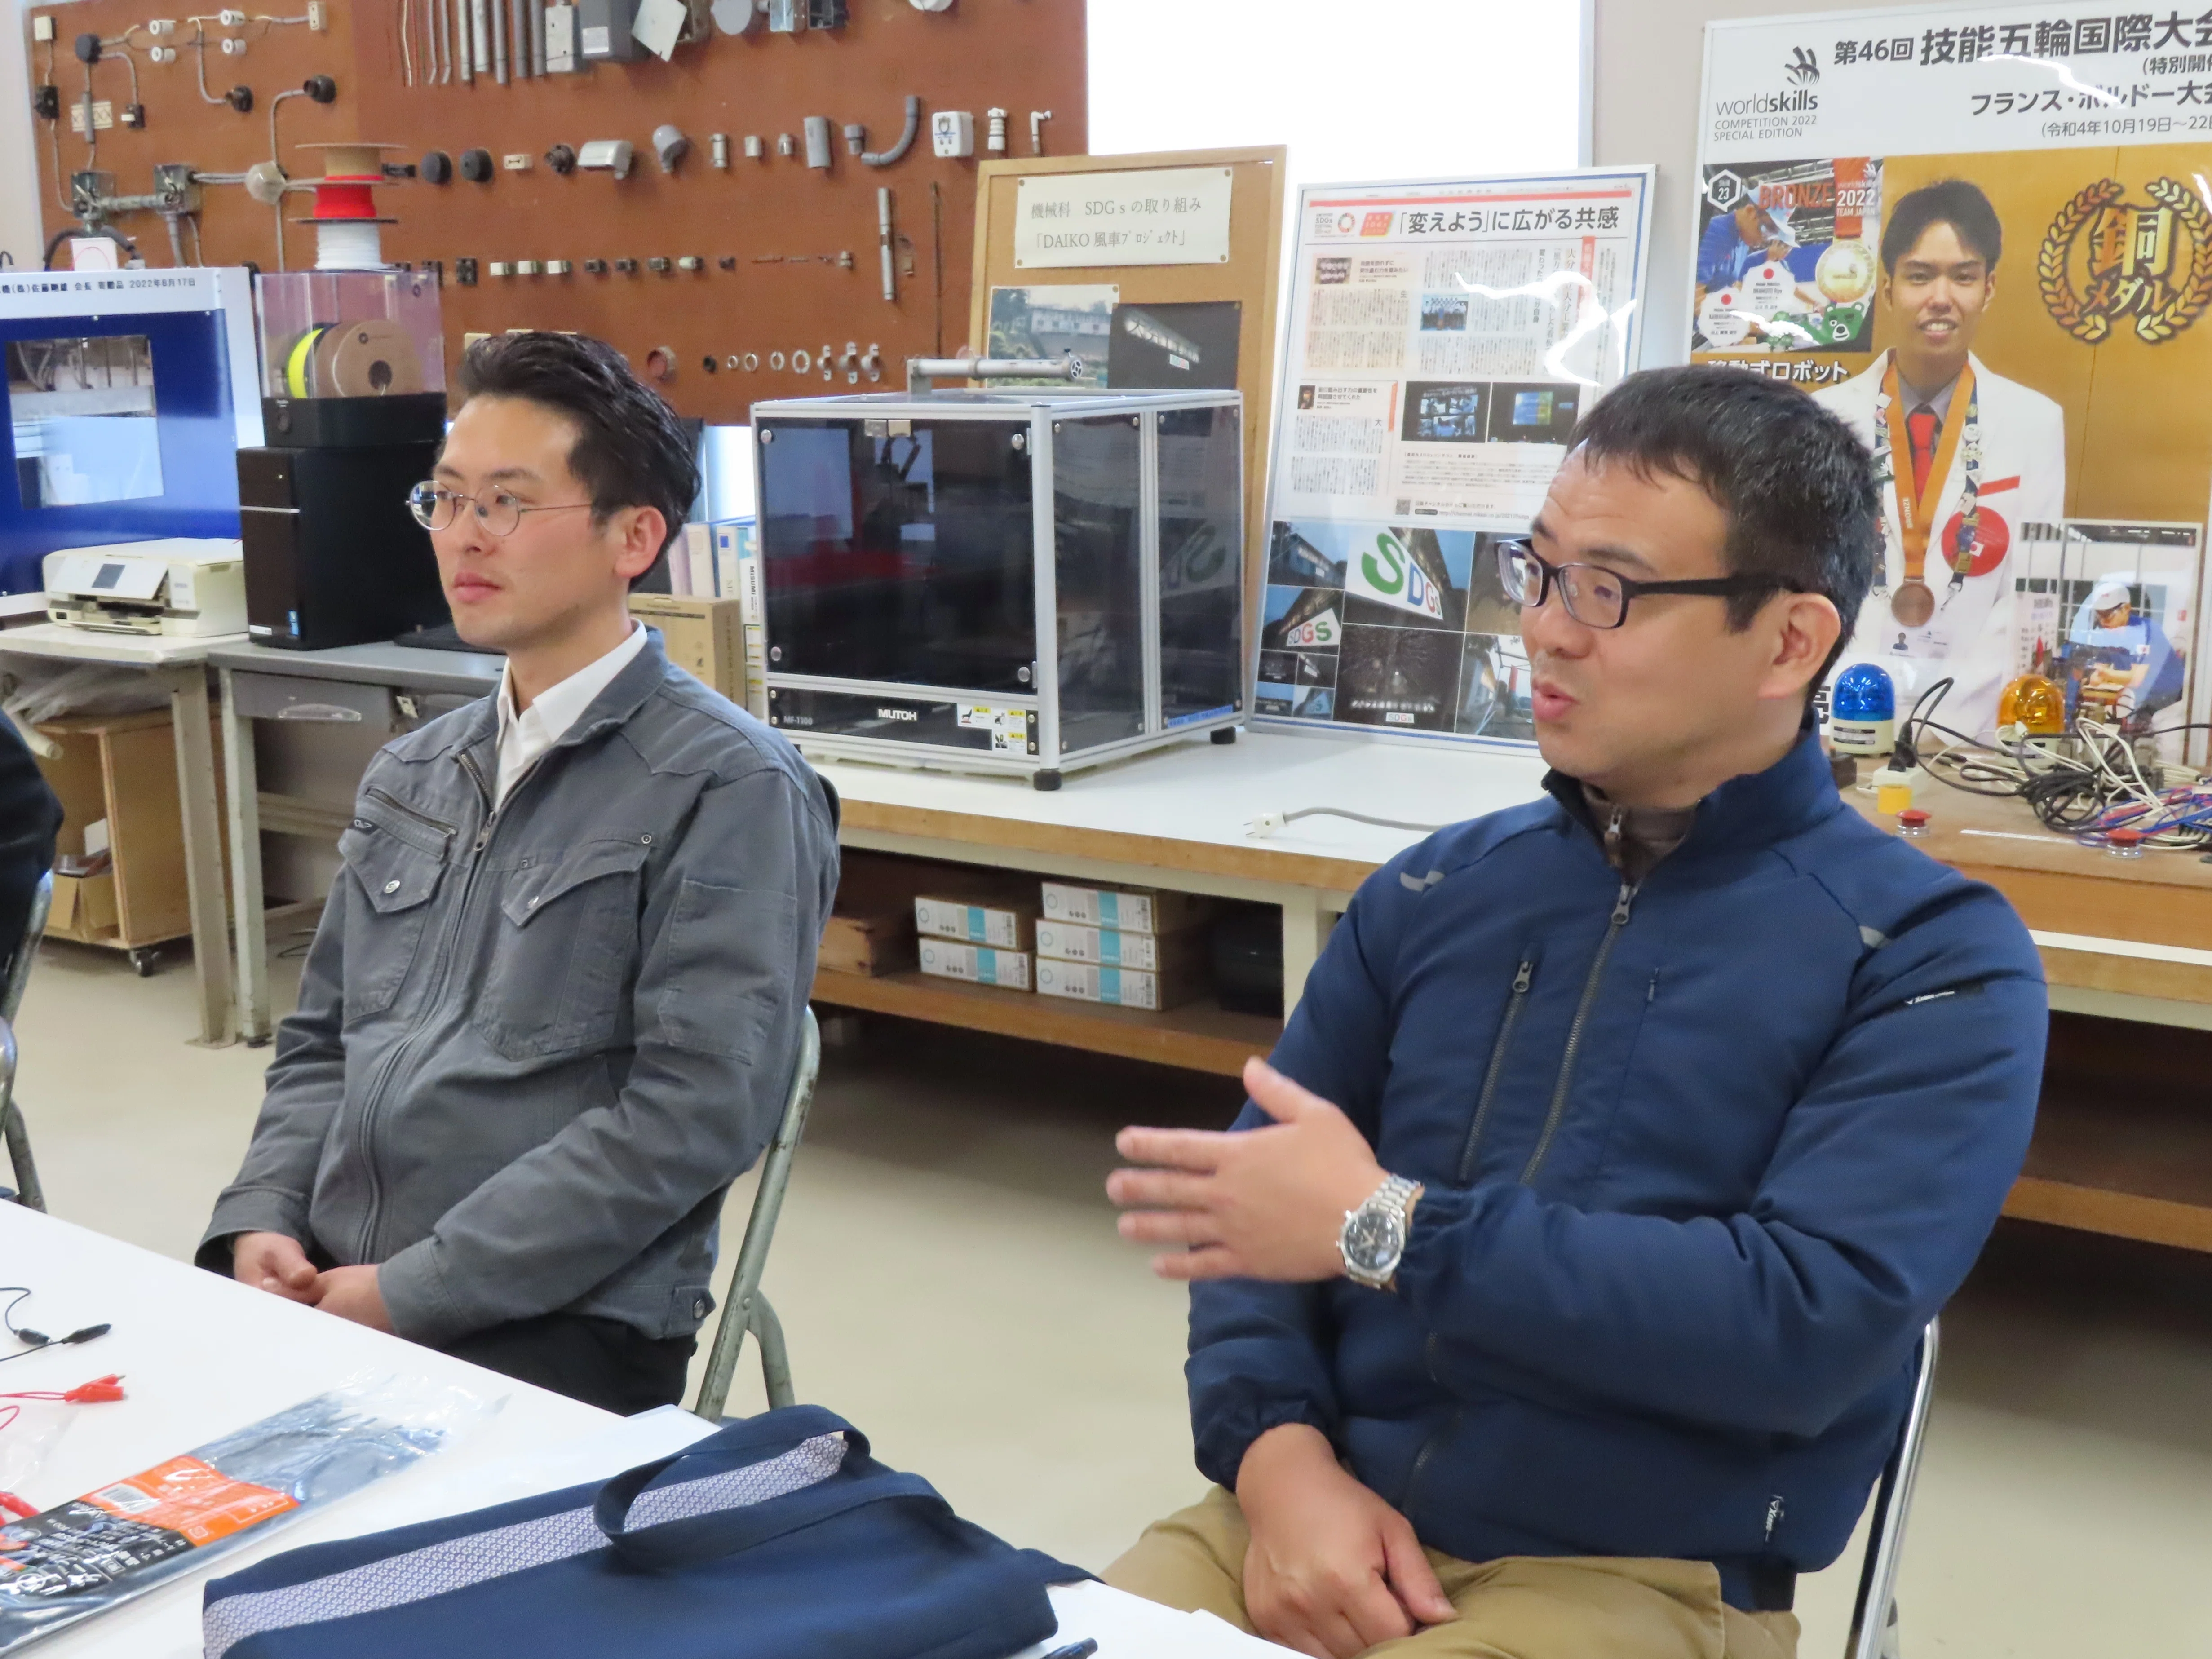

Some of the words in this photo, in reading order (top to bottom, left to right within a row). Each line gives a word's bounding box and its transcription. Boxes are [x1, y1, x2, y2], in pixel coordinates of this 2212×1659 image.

[1833, 37, 1915, 65] 第46回
[2142, 53, 2212, 75] (特別開
[1716, 89, 1818, 115] worldskills
[1715, 117, 1788, 130] COMPETITION
[1792, 115, 1817, 126] 2022
[2041, 115, 2212, 138] (令和4年10月19日～22
[1714, 130, 1754, 141] SPECIAL
[1758, 127, 1802, 139] EDITION
[1717, 187, 1730, 200] 23
[1758, 181, 1834, 210] BRONZE
[1837, 189, 1876, 207] 2022
[1031, 201, 1070, 219] 機械科
[1399, 206, 1619, 234] 「変えよう」に広がる共感
[1836, 208, 1854, 217] TEAM
[1855, 207, 1876, 217] JAPAN
[2091, 206, 2174, 277] 銅
[129, 278, 195, 288] 2022年8月17日
[2082, 277, 2172, 315] メダル
[1902, 496, 1914, 530] BRONZE
[878, 708, 917, 721] MUTOH
